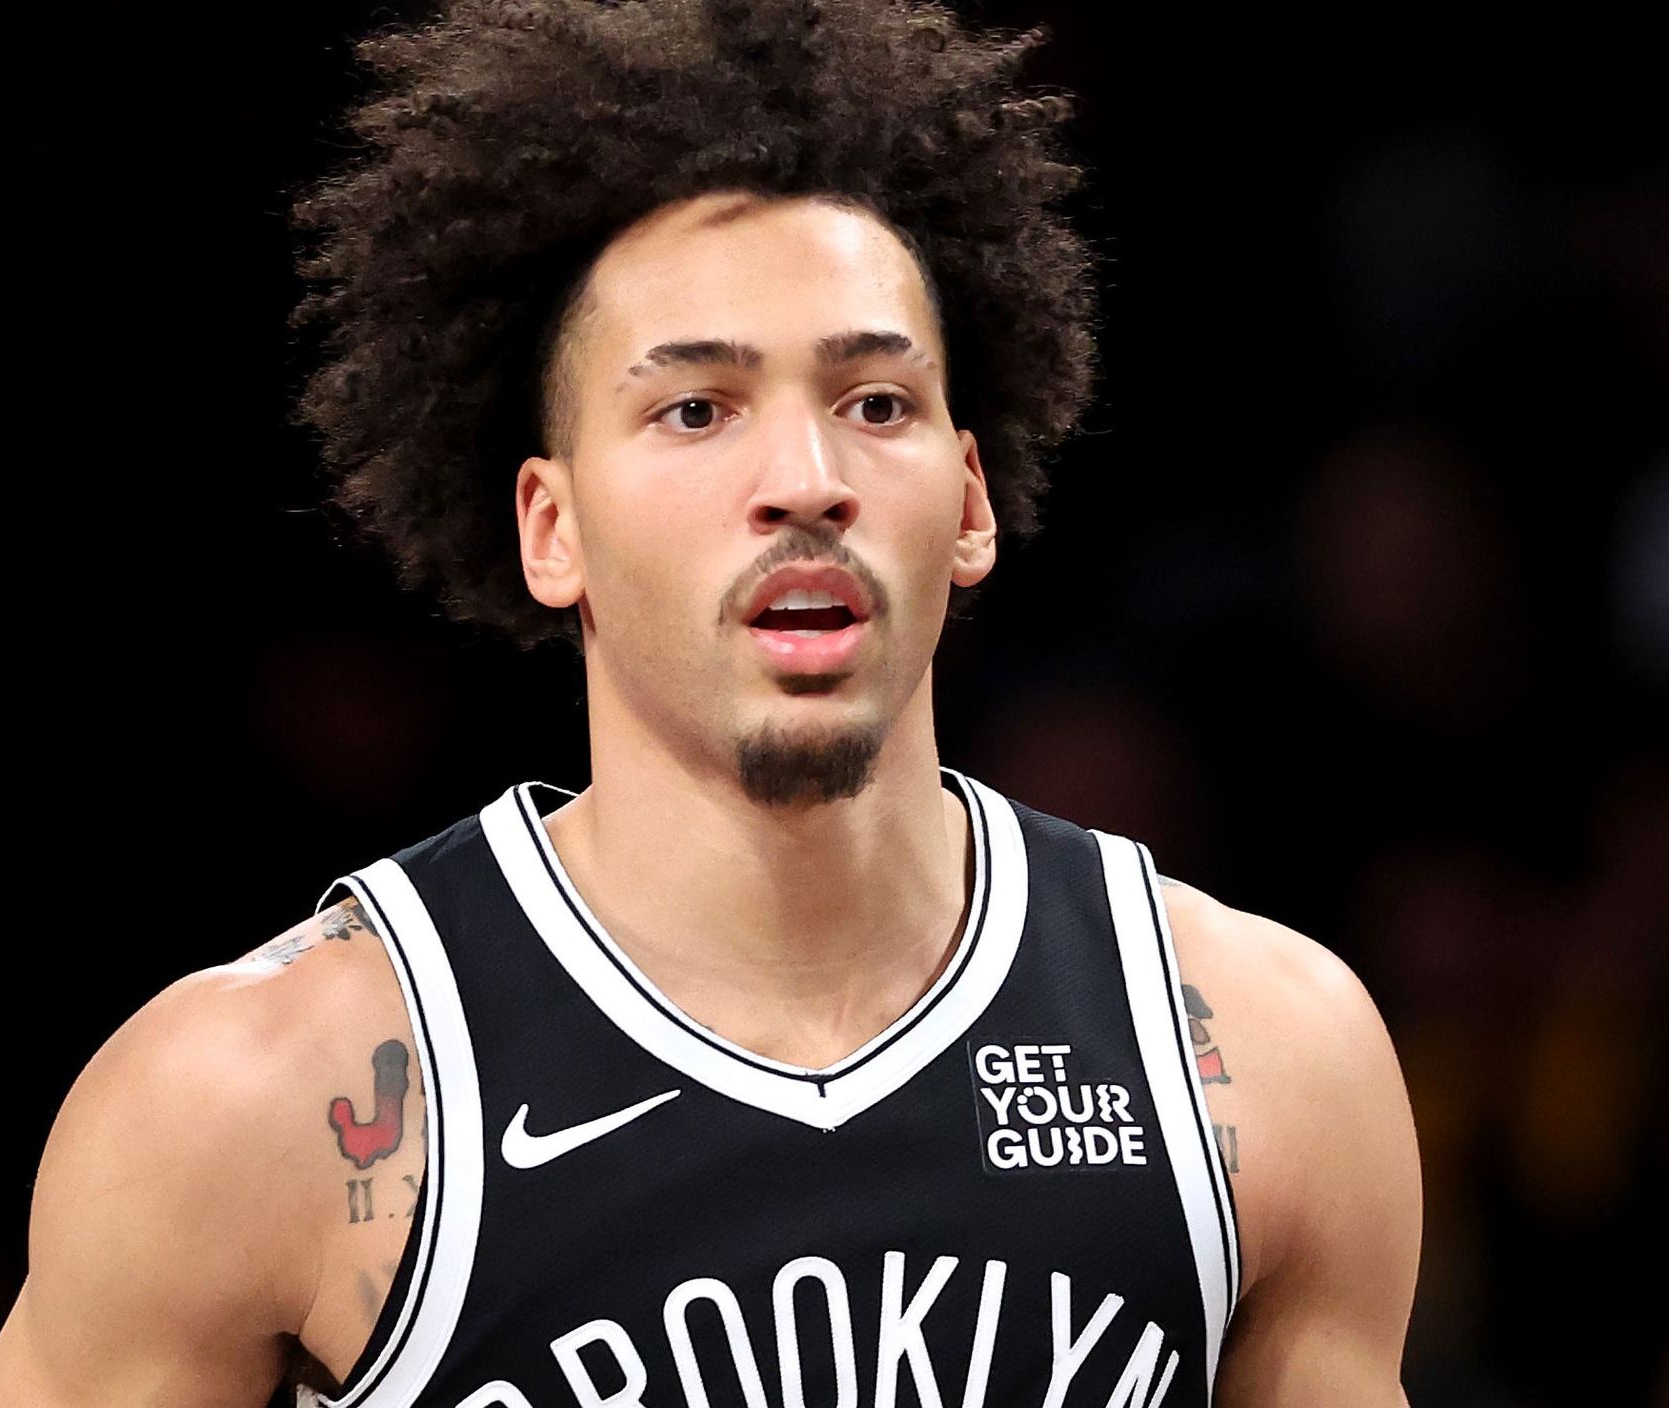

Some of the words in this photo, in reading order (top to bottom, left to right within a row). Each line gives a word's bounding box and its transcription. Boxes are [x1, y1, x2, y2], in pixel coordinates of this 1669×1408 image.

[975, 1044, 1072, 1084] GET
[980, 1084, 1135, 1126] YOUR
[987, 1126, 1147, 1169] GUIDE
